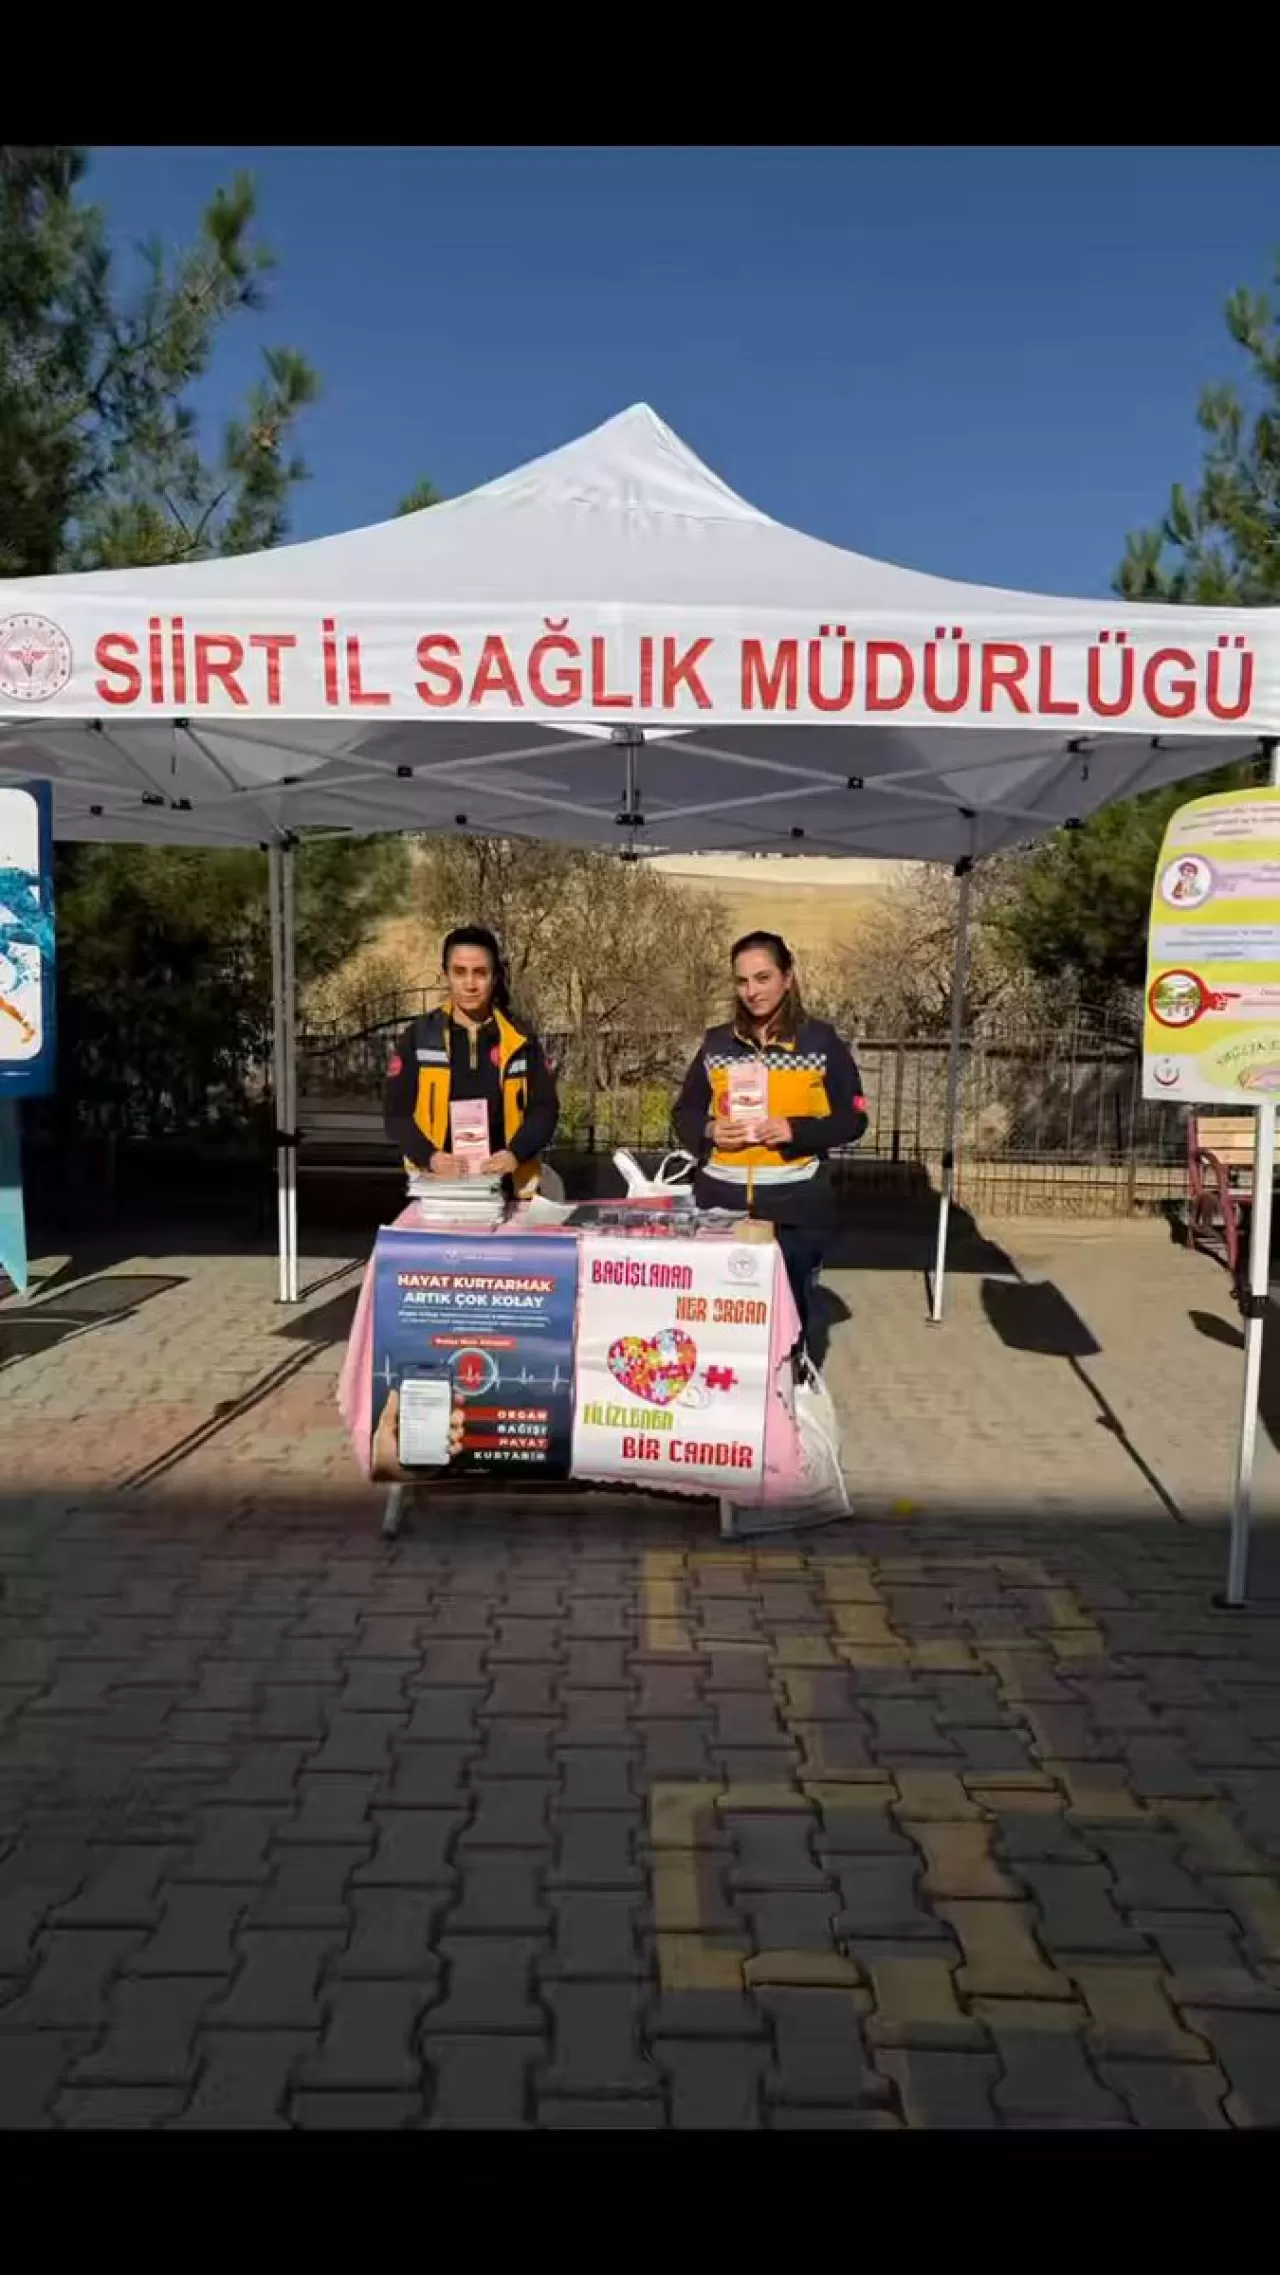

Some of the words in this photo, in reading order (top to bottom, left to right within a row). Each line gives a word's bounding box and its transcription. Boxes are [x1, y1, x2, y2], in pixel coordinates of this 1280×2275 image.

[95, 616, 298, 706] SİİRT
[322, 616, 393, 707] İL
[417, 617, 714, 710] SAĞLIK
[397, 1274, 449, 1288] HAYAT
[453, 1276, 553, 1292] KURTARMAK
[403, 1292, 451, 1305] ARTIK
[454, 1294, 487, 1308] ÇOK
[492, 1295, 545, 1308] KOLAY
[675, 1296, 707, 1323] HER
[497, 1409, 548, 1420] ORGAN
[498, 1438, 548, 1449] HAYAT
[622, 1433, 661, 1461] BİR
